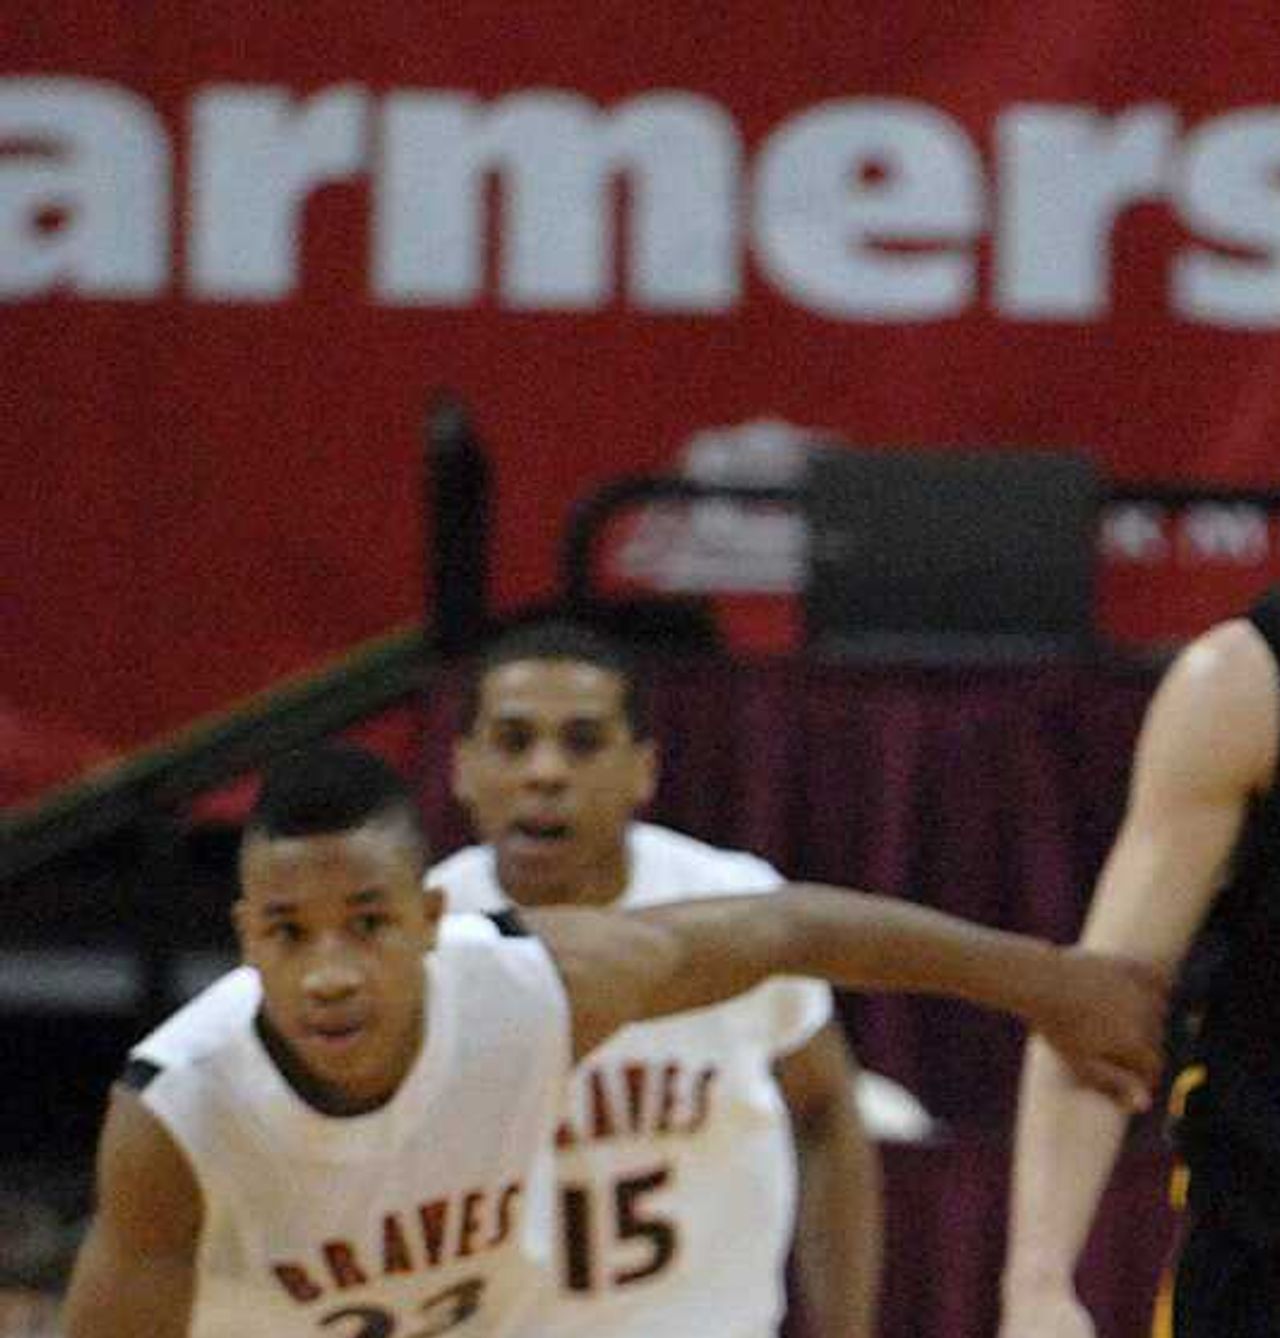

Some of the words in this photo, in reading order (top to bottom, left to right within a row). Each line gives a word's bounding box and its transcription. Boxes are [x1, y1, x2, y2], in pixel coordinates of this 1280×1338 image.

[555, 1060, 716, 1150] AVES
[269, 1178, 523, 1306] BRAVES
[563, 1166, 678, 1291] 15
